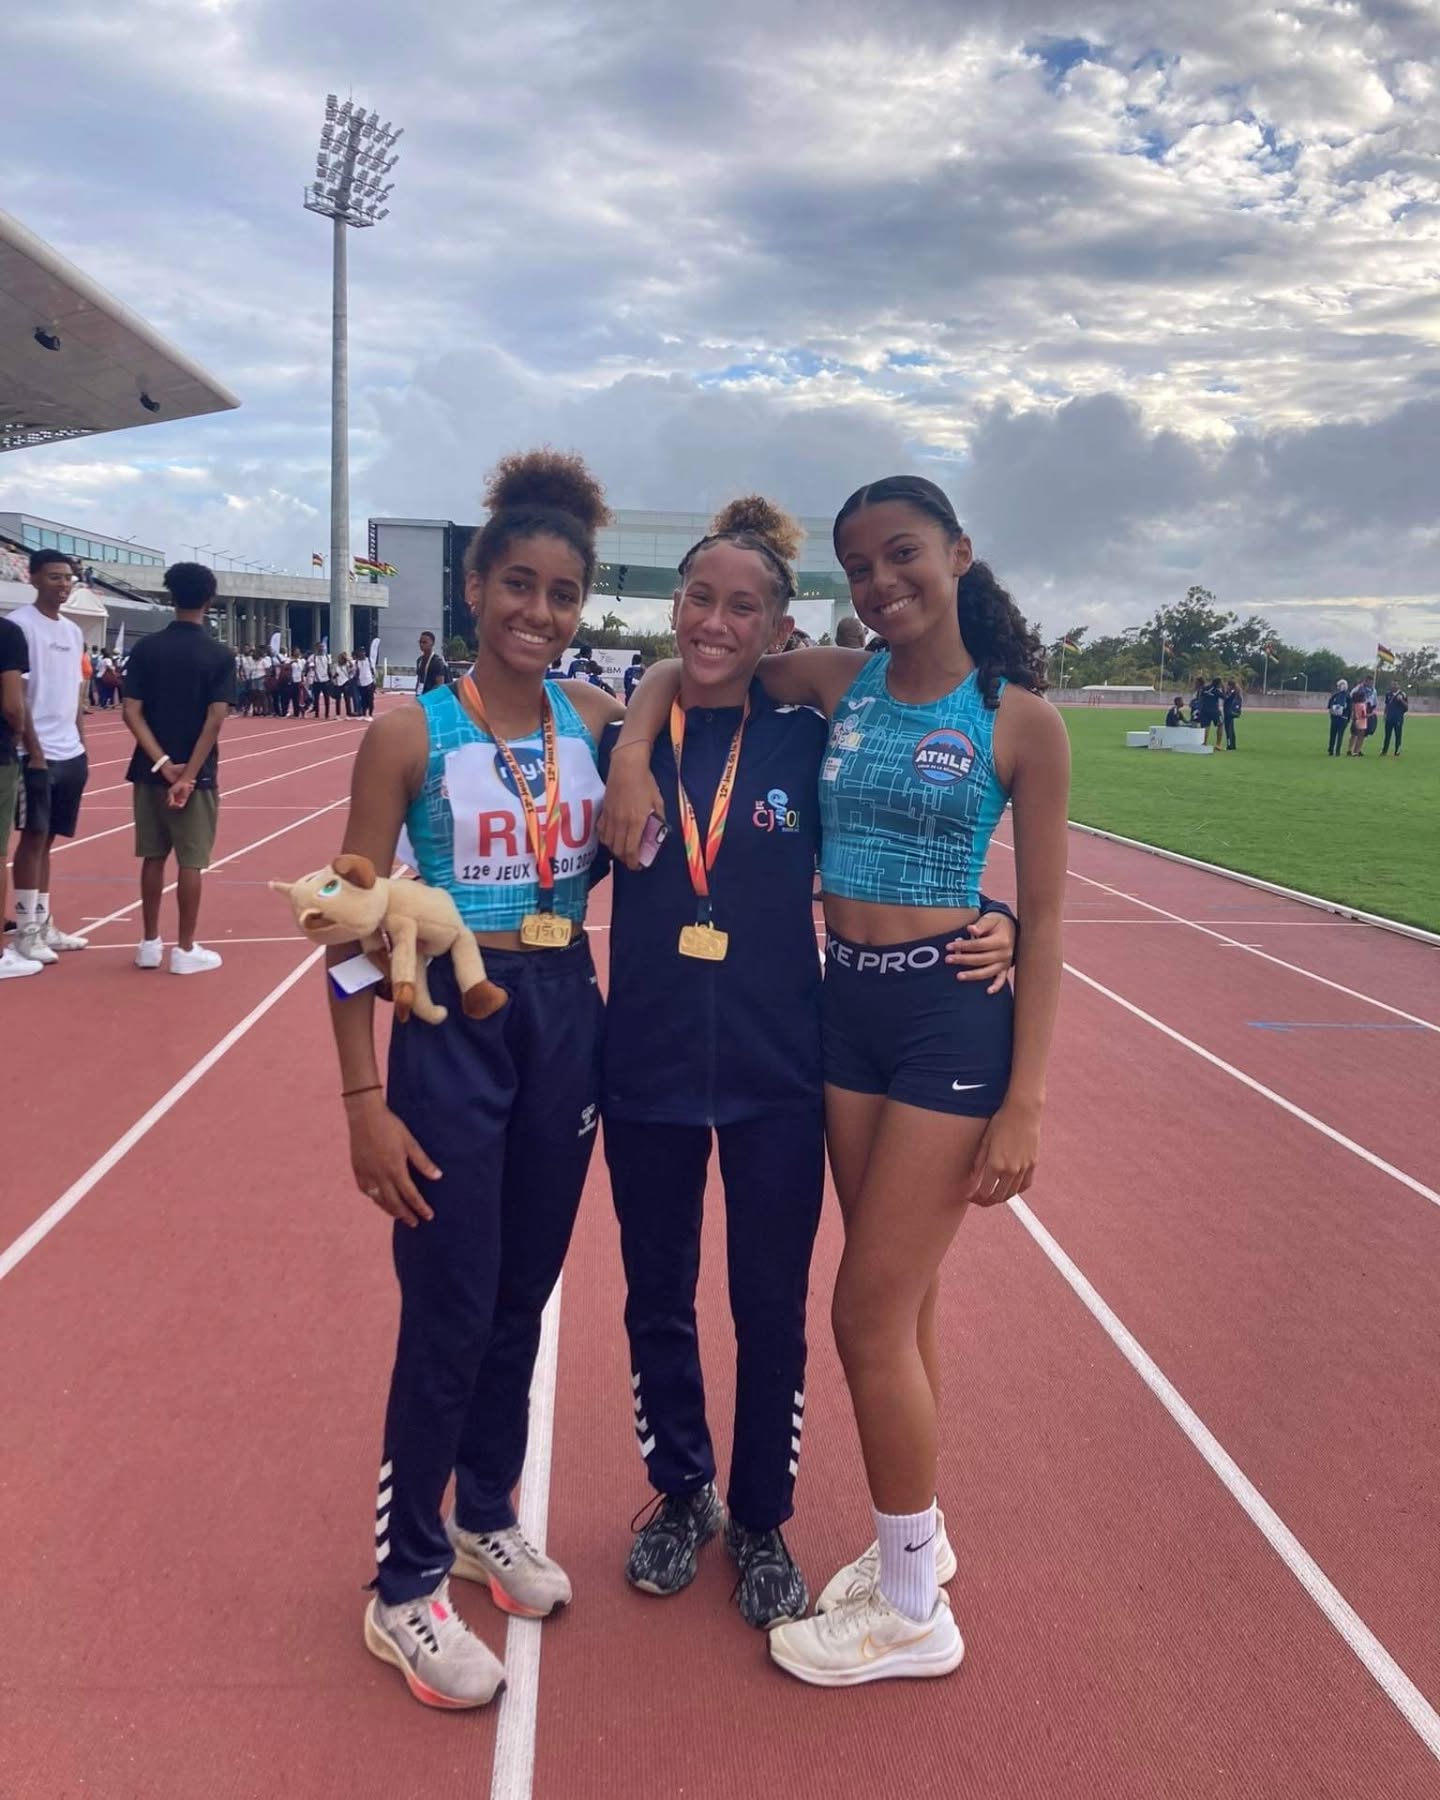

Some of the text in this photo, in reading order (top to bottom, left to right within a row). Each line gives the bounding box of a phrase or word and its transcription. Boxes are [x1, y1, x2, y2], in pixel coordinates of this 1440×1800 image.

[915, 750, 971, 773] ATHLE
[463, 865, 490, 879] 12e
[496, 863, 530, 880] JEUX
[857, 946, 939, 974] PRO
